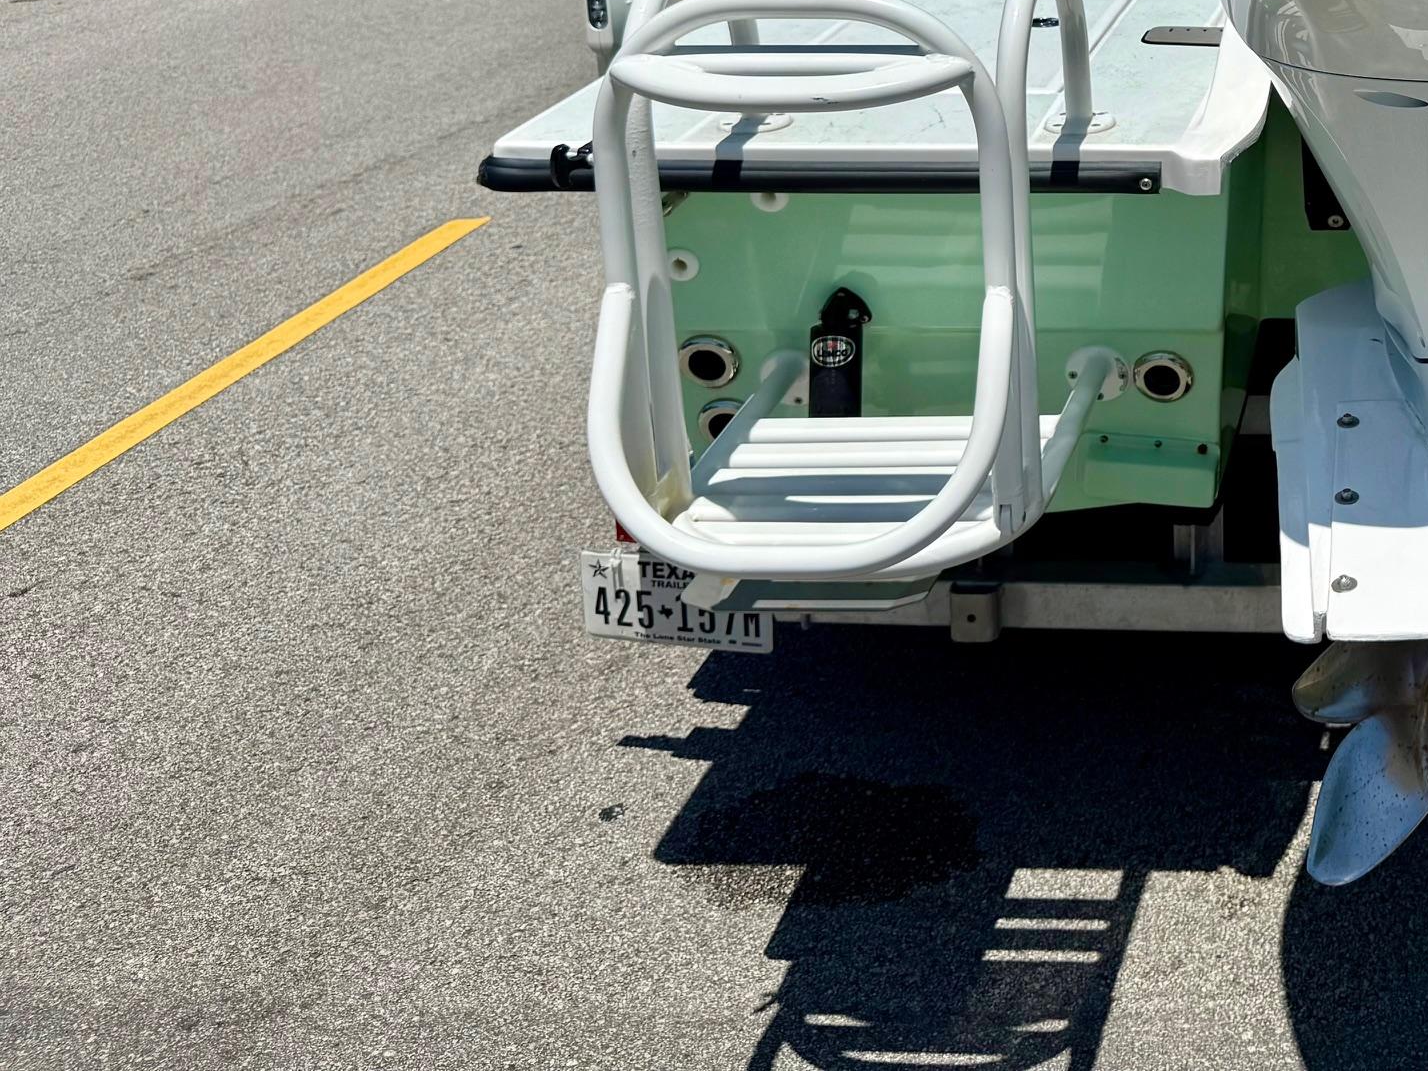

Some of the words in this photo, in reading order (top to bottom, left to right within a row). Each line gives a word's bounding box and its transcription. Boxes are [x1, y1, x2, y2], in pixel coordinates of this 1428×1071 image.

[637, 561, 696, 580] TEXA
[651, 579, 690, 589] TRAILE
[634, 631, 651, 639] The
[652, 633, 675, 641] Lone
[677, 635, 695, 643] Star
[698, 637, 722, 645] State
